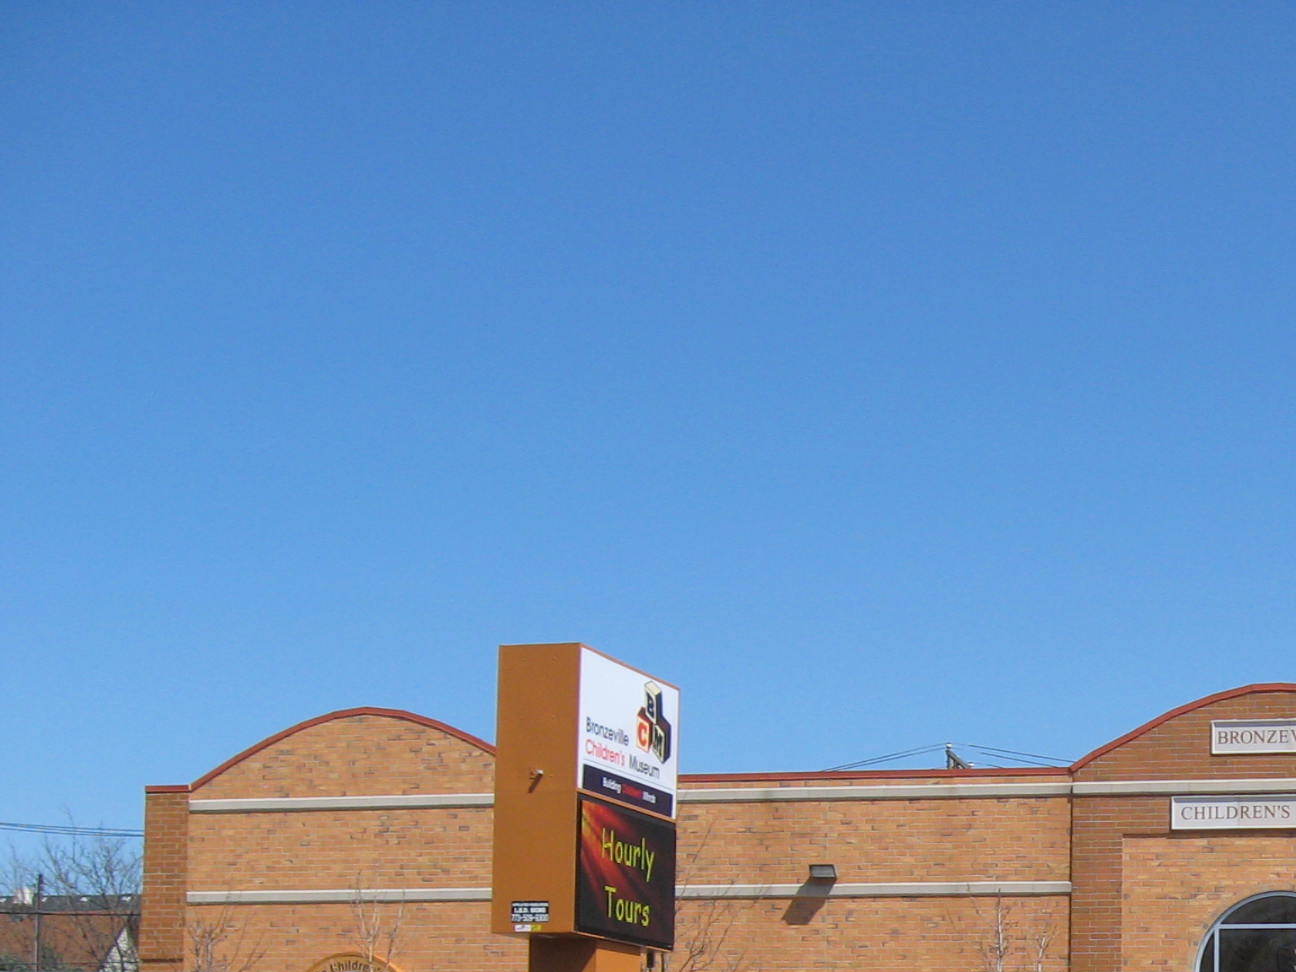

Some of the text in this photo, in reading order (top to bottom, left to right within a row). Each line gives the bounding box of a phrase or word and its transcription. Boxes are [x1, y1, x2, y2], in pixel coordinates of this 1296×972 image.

[586, 716, 629, 747] Bronzeville
[637, 722, 649, 747] C
[585, 739, 660, 779] Children's Museum
[1180, 805, 1290, 820] CHILDREN'S
[602, 827, 655, 882] Hourly
[604, 885, 650, 926] Tours
